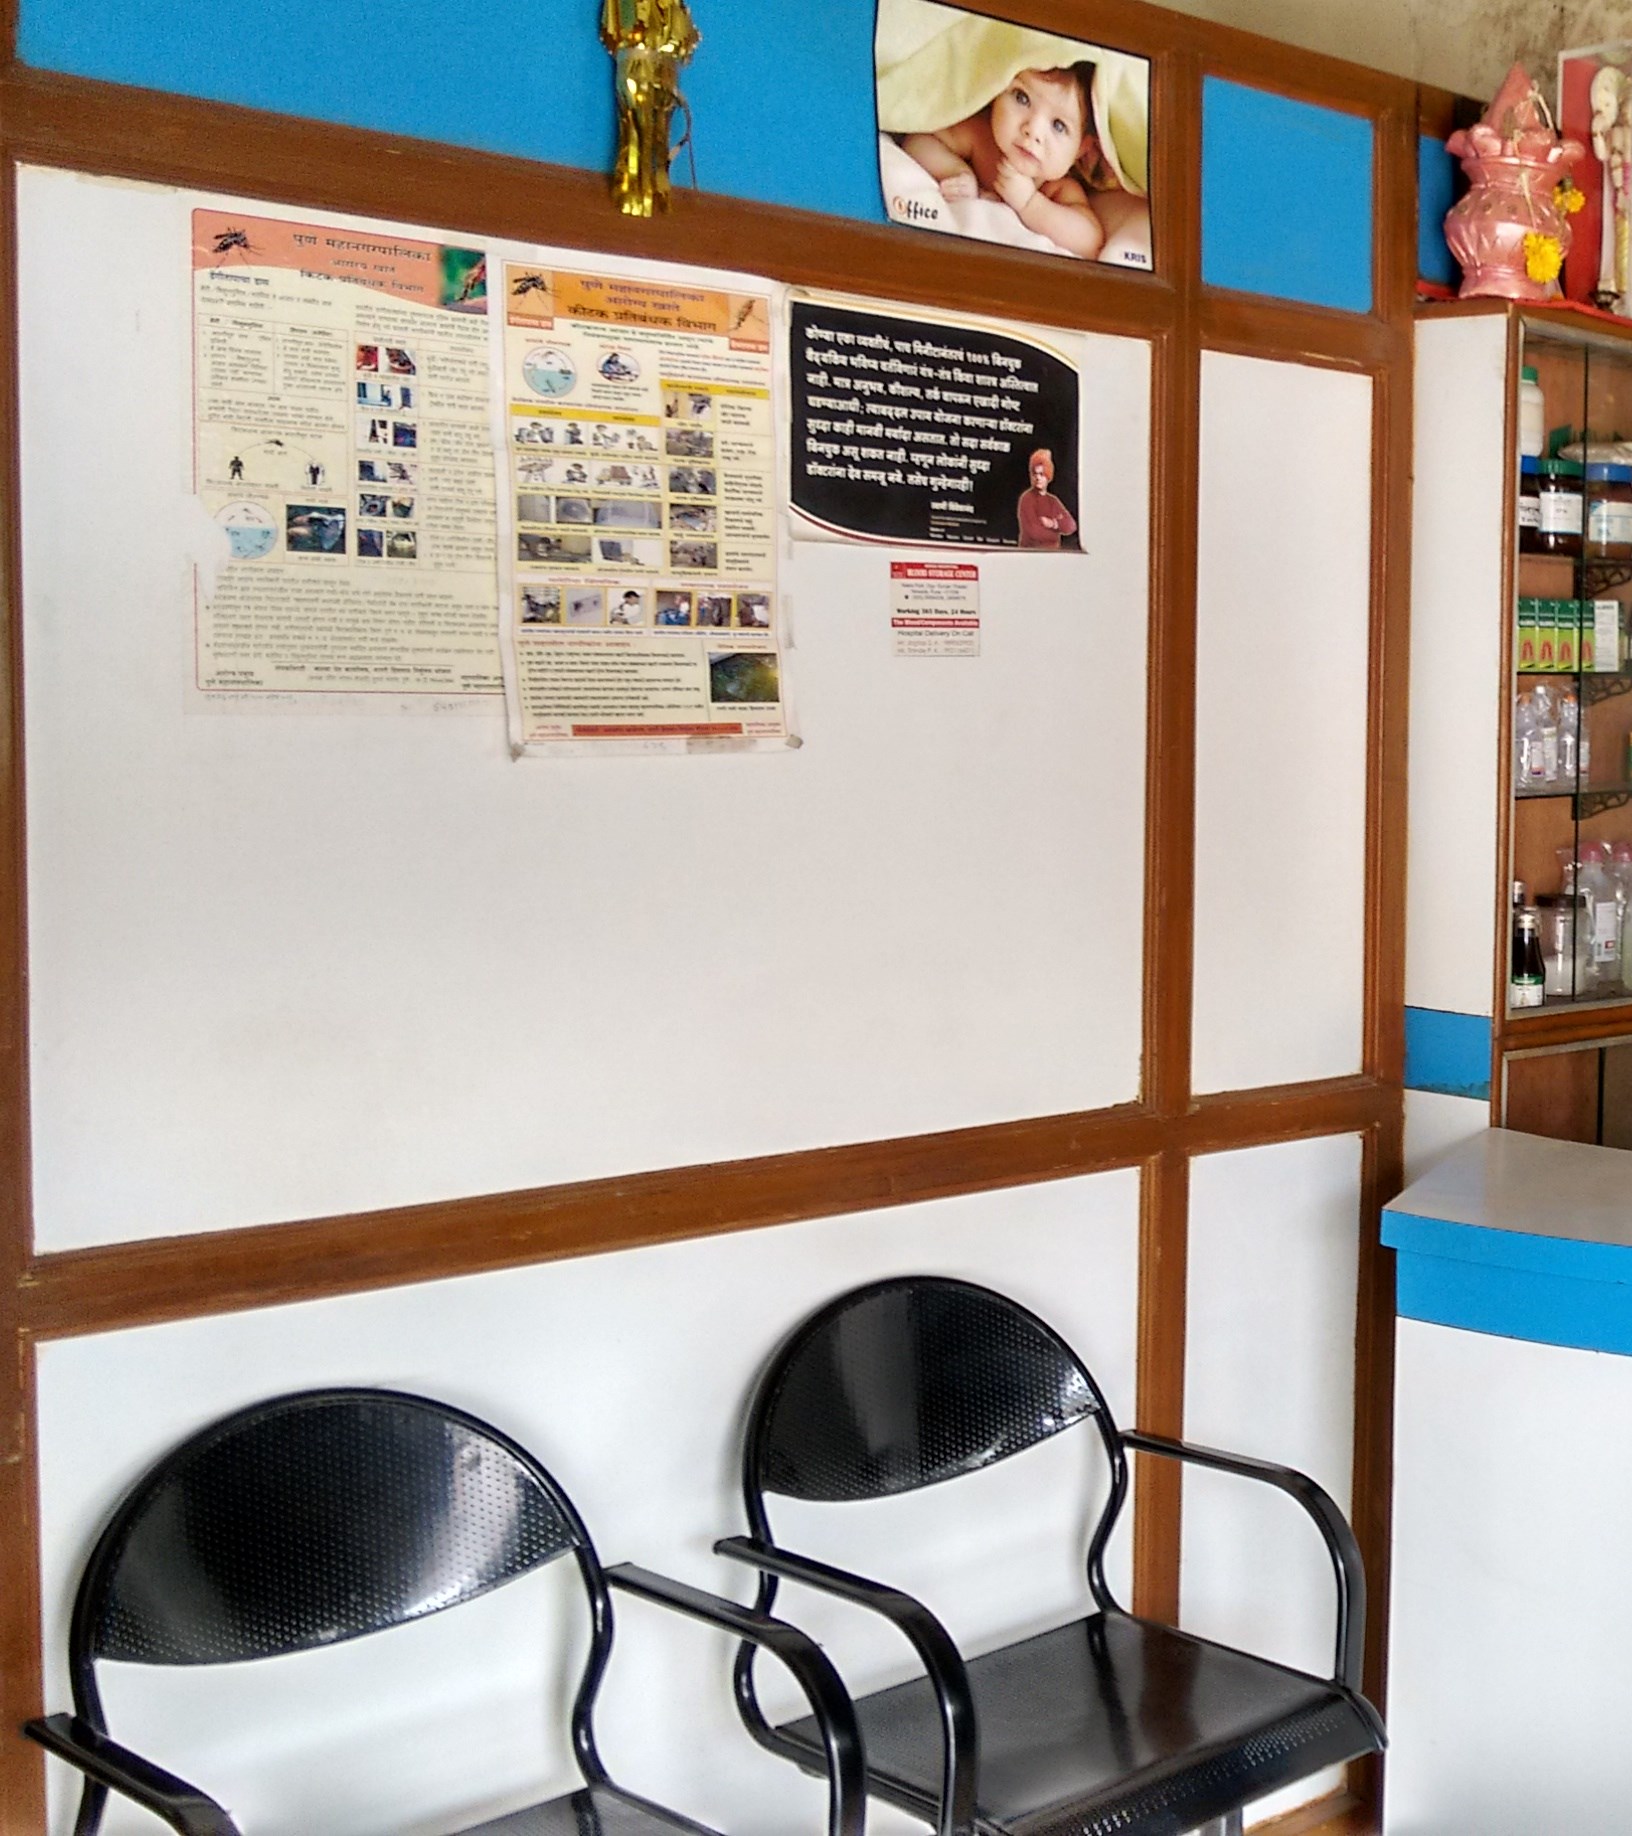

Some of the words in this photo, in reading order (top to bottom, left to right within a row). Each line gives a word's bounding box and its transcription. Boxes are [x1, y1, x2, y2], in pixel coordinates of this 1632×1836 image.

[326, 238, 432, 261] महानगरपालिका
[1124, 251, 1147, 264] KRIS
[676, 316, 717, 332] विभाग
